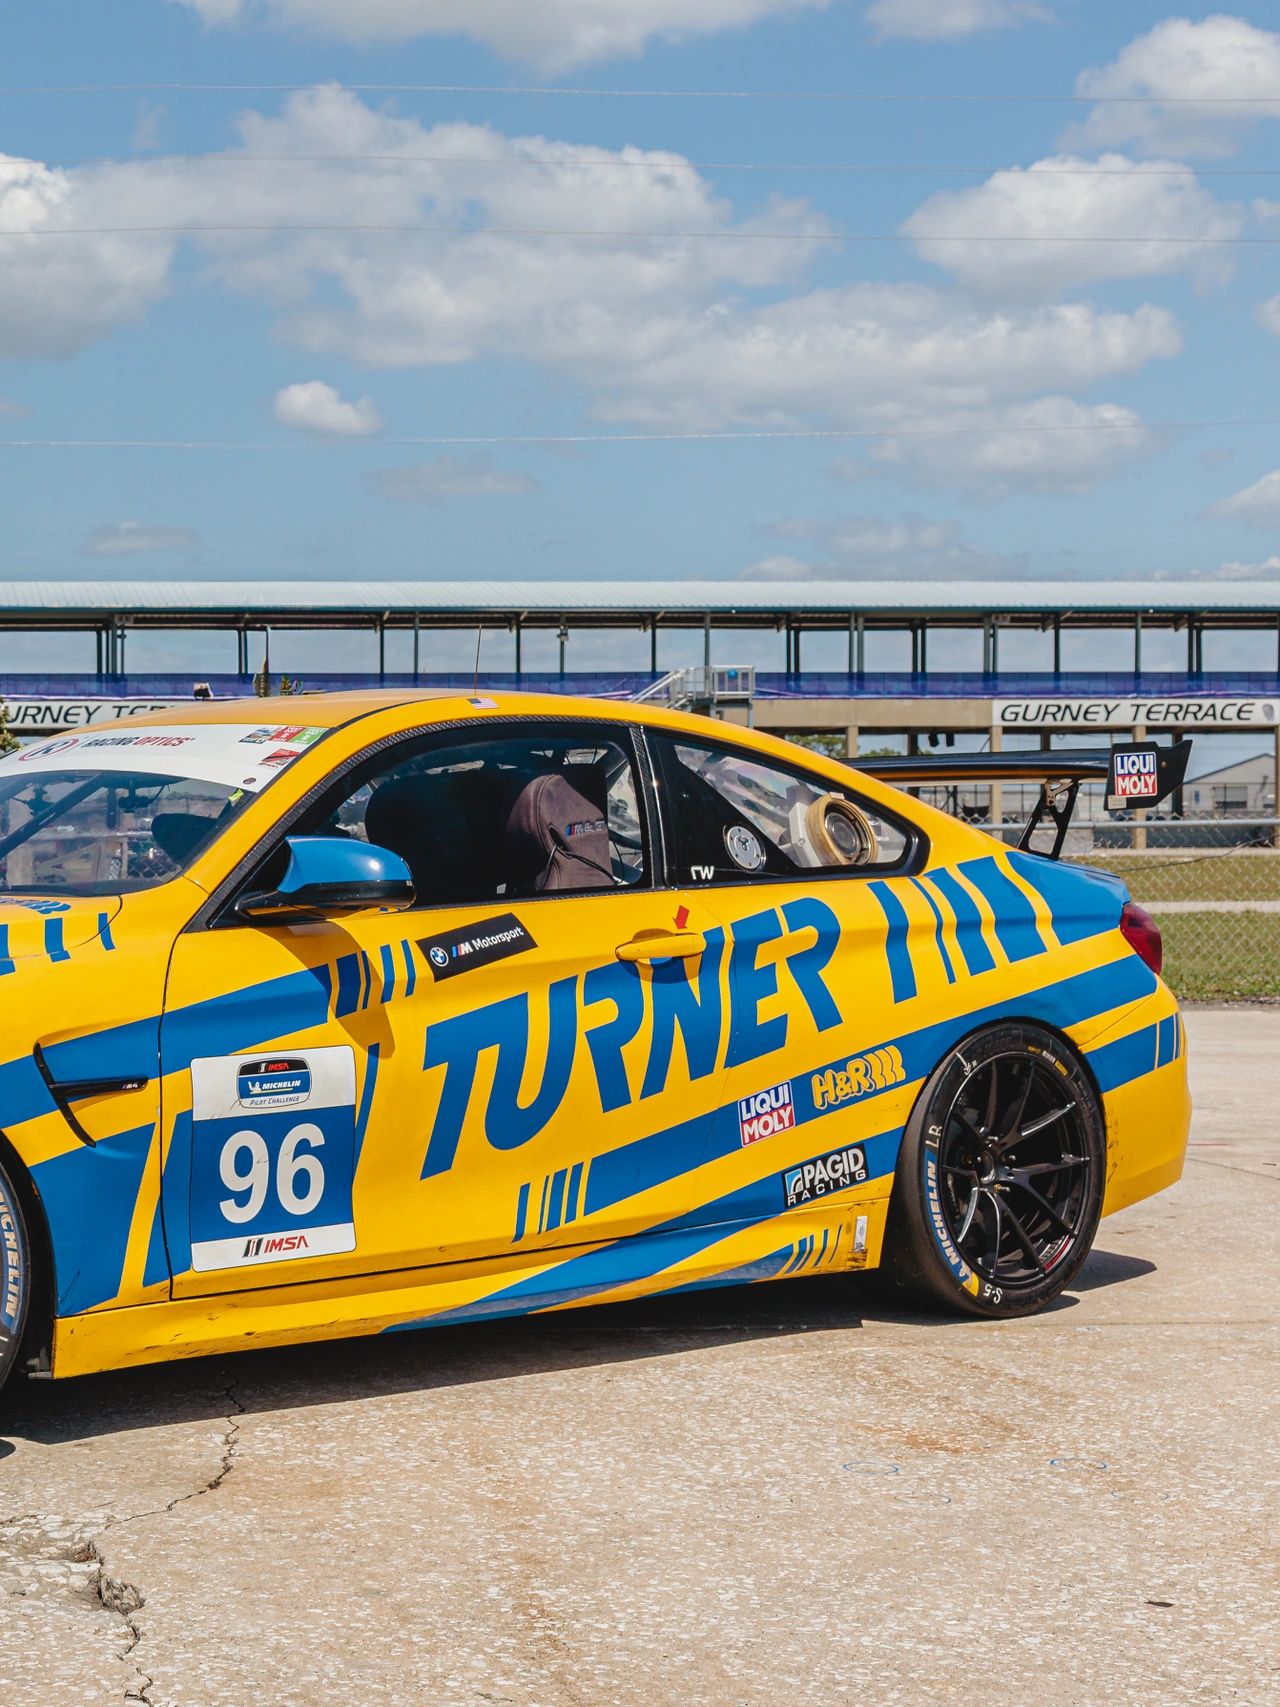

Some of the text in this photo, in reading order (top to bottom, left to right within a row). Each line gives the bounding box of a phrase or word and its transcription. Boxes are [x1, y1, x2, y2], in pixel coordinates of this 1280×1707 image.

[1000, 703, 1255, 722] GURNEY TERRACE
[1116, 754, 1154, 775] LIQUI
[1117, 774, 1156, 795] MOLY
[472, 926, 525, 950] Motorsport
[420, 897, 843, 1181] TURNER
[261, 1079, 302, 1091] MICHELIN
[249, 1095, 300, 1107] PILOT CHALLENGE
[740, 1083, 790, 1121] LIQUI
[742, 1105, 793, 1144] MOLY
[219, 1123, 326, 1224] 96
[803, 1147, 865, 1189] PAGID
[787, 1168, 867, 1206] RACING
[925, 1160, 962, 1265] MICHELIN
[263, 1235, 310, 1254] IMSA
